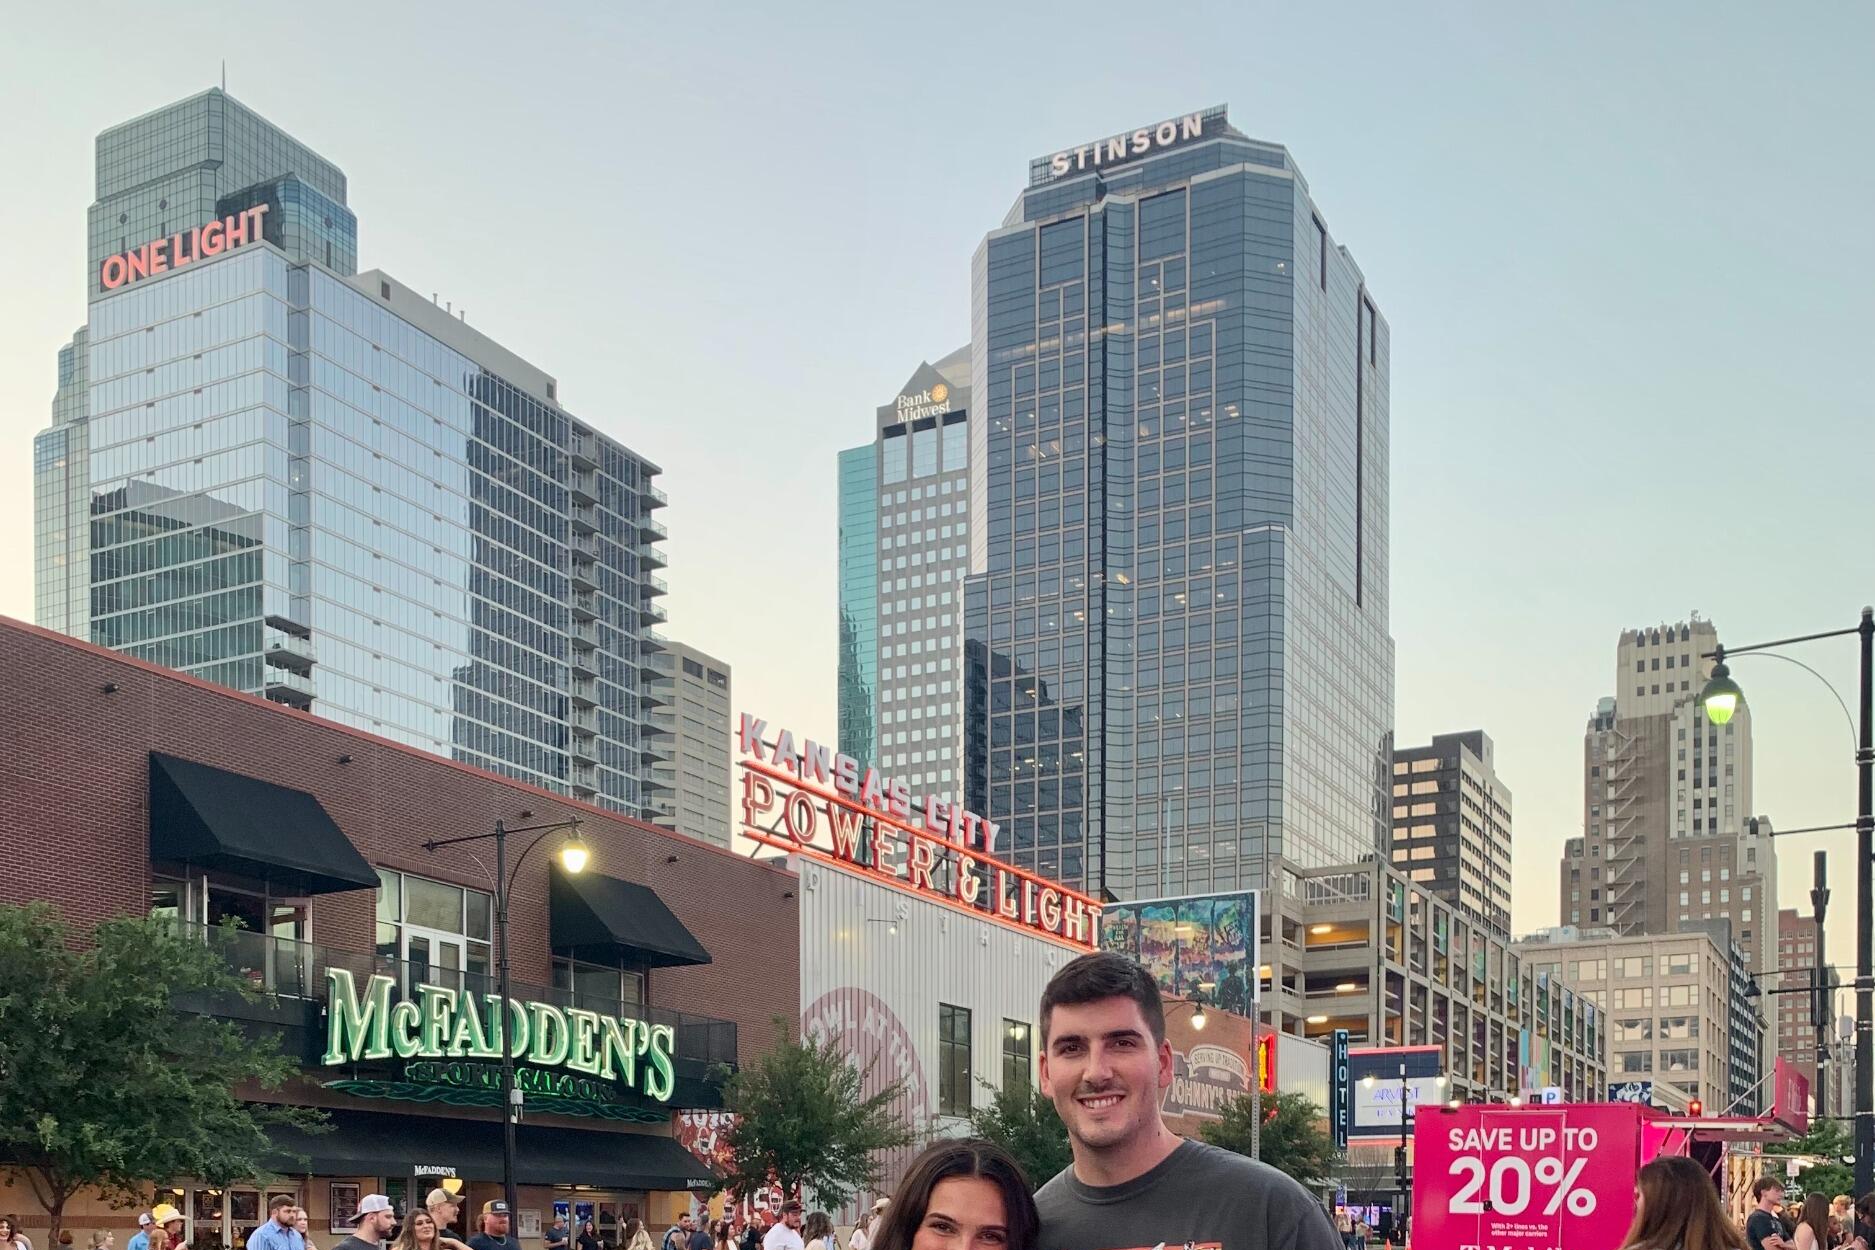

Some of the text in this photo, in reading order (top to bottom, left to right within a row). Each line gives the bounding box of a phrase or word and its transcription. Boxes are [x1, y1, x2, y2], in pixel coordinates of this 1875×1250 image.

[1052, 113, 1203, 177] STINSON
[102, 203, 270, 289] ONE LIGHT
[897, 390, 932, 410] Bank
[897, 399, 951, 424] Midwest
[741, 712, 1001, 853] KANSAS CITY
[743, 771, 1102, 948] POWER & LIGHT
[321, 967, 675, 1102] McFADDEN'S
[1171, 1077, 1224, 1110] JOHNNY'S
[1337, 1043, 1347, 1148] HOTEL
[1546, 1092, 1557, 1104] P
[1448, 1126, 1599, 1152] SAVE UP TO
[1448, 1155, 1598, 1217] 20%
[1508, 1230, 1525, 1238] major
